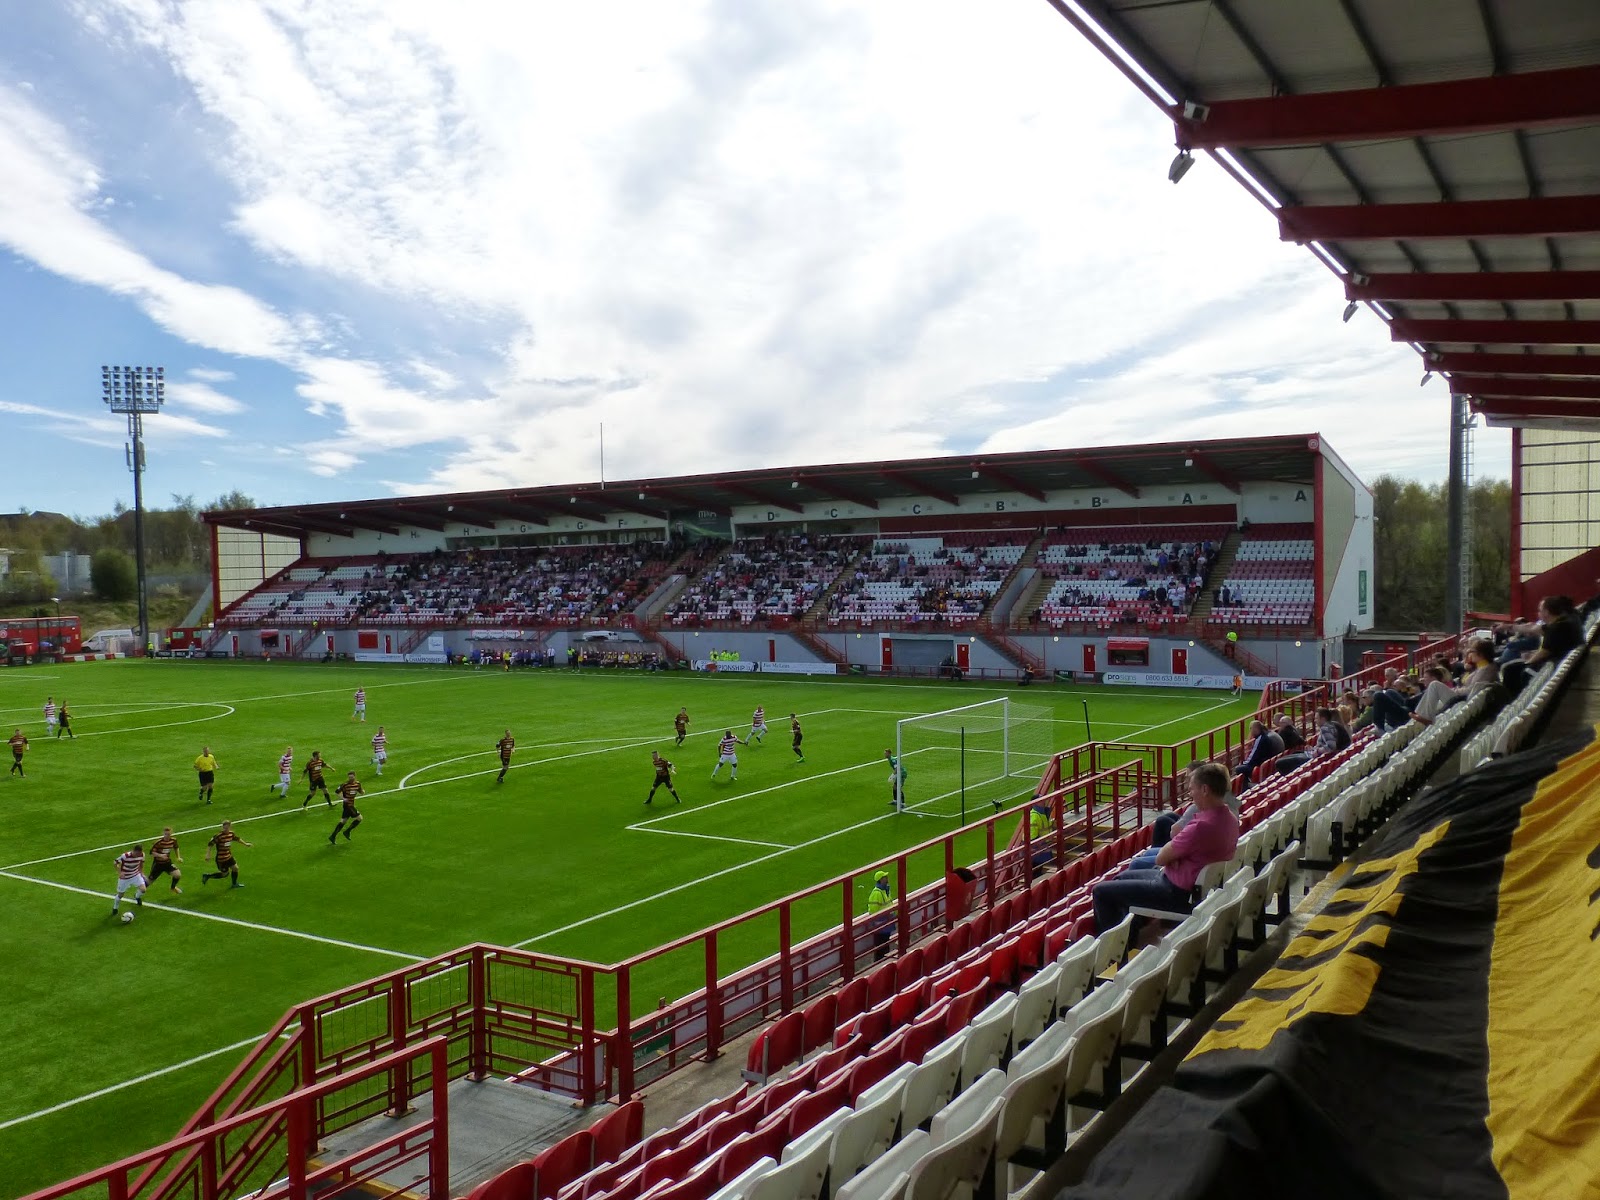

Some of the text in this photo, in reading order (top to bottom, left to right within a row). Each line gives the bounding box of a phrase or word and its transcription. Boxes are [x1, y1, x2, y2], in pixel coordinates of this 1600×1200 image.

[1182, 493, 1193, 505] A
[1295, 490, 1307, 502] A
[996, 501, 1005, 511] B
[1092, 497, 1102, 508] B
[830, 508, 838, 518] C
[912, 504, 921, 514] C
[767, 511, 775, 521] D
[520, 524, 527, 533] G
[577, 521, 584, 530] G
[618, 519, 624, 528] F
[410, 531, 417, 539] H
[463, 527, 470, 536] H
